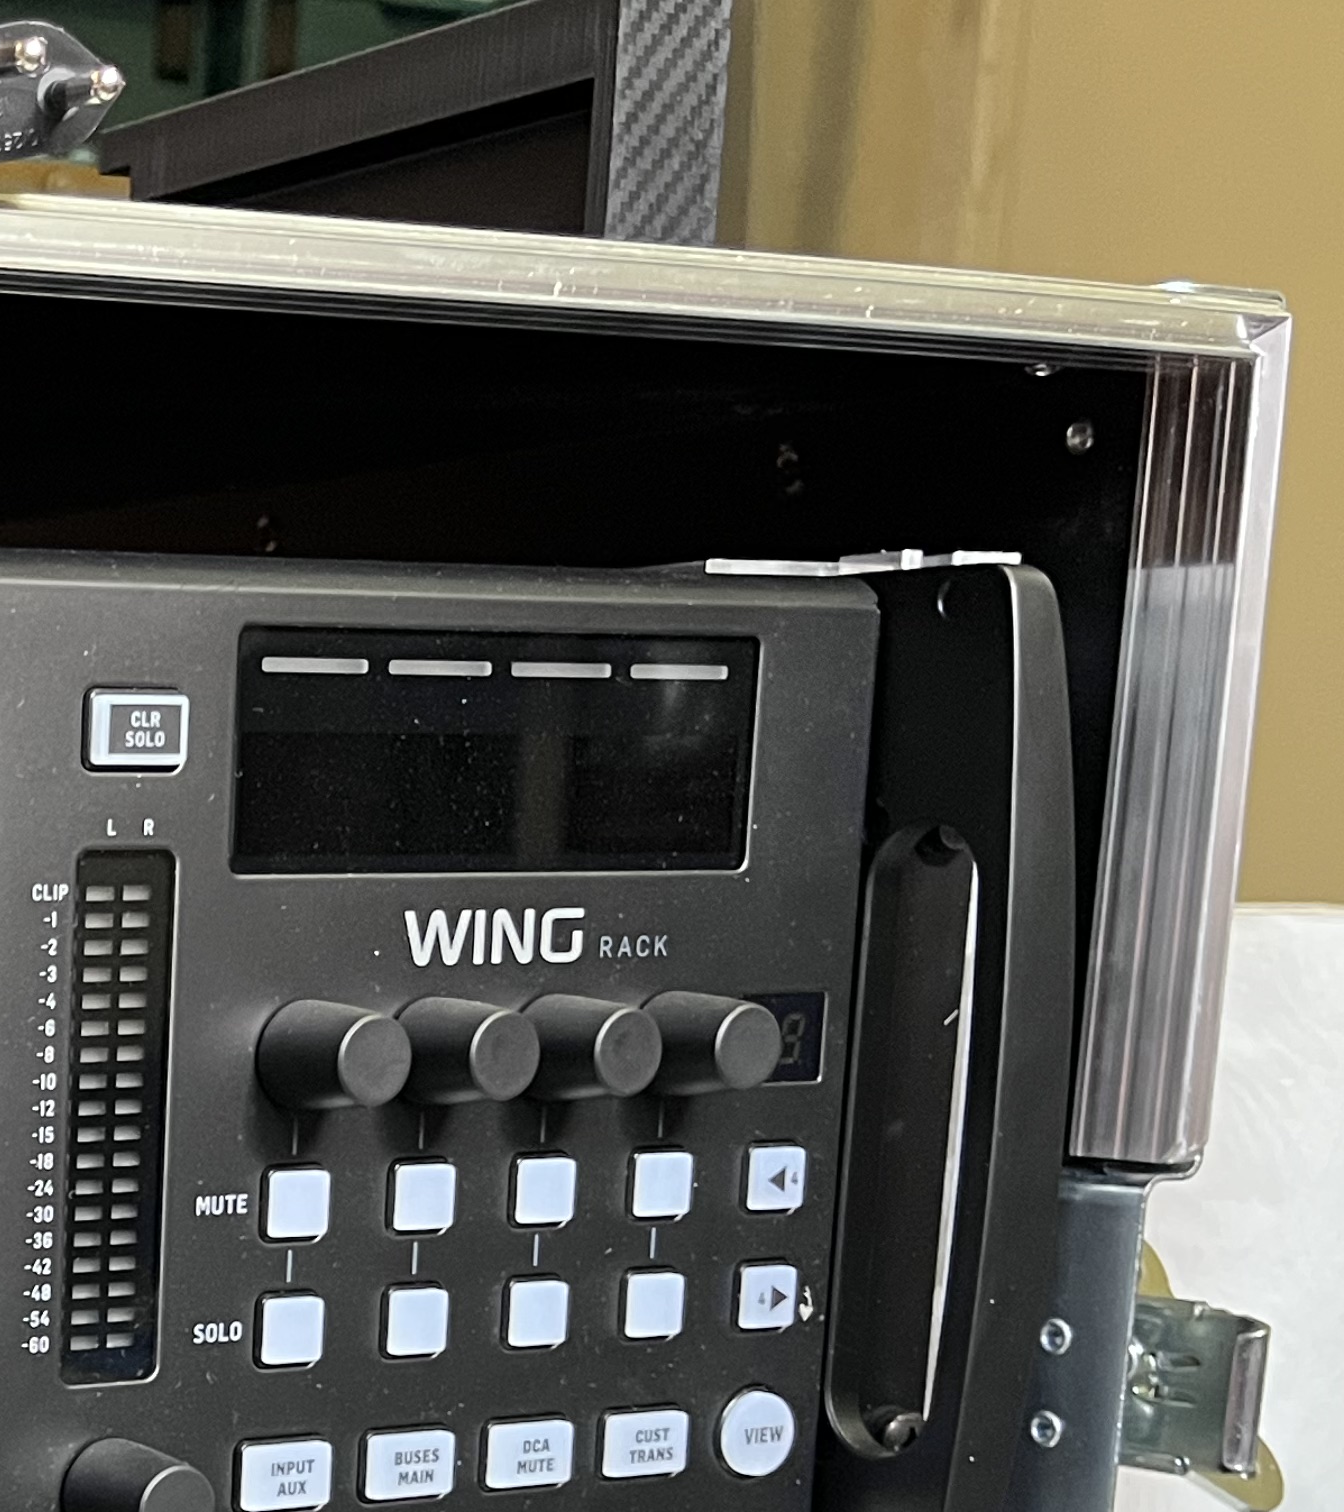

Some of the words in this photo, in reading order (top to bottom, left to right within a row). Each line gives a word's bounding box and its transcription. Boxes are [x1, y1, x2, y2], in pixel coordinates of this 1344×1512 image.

[130, 710, 161, 728] CLR
[125, 730, 166, 748] SOLO
[106, 818, 117, 837] L
[143, 818, 155, 836] R
[32, 883, 69, 902] CLIP
[43, 910, 58, 928] -1
[40, 937, 58, 956] -2
[404, 907, 585, 967] WING
[599, 934, 668, 958] RACK
[39, 964, 57, 983] -3
[38, 992, 56, 1010] -4
[37, 1018, 56, 1037] -6
[36, 1045, 55, 1064] -8
[32, 1072, 57, 1091] -10
[31, 1099, 56, 1117] -12
[31, 1125, 55, 1144] -15
[29, 1152, 54, 1170] -18
[27, 1179, 54, 1197] -24
[26, 1205, 54, 1223] -30
[195, 1193, 249, 1217] MUTE
[25, 1231, 53, 1250] -36
[23, 1257, 52, 1275] -42
[23, 1283, 52, 1302] -48
[22, 1309, 50, 1328] -54
[192, 1320, 243, 1344] SOLO
[21, 1335, 50, 1354] -60
[635, 1427, 670, 1444] CUST
[744, 1425, 784, 1445] VIEW
[522, 1438, 550, 1454] DCA
[629, 1446, 674, 1464] TRANS
[394, 1448, 440, 1466] BUSES
[516, 1457, 555, 1475] MUTE
[270, 1458, 315, 1477] INPUT
[397, 1469, 434, 1486] MAIN
[276, 1480, 307, 1497] AUX
